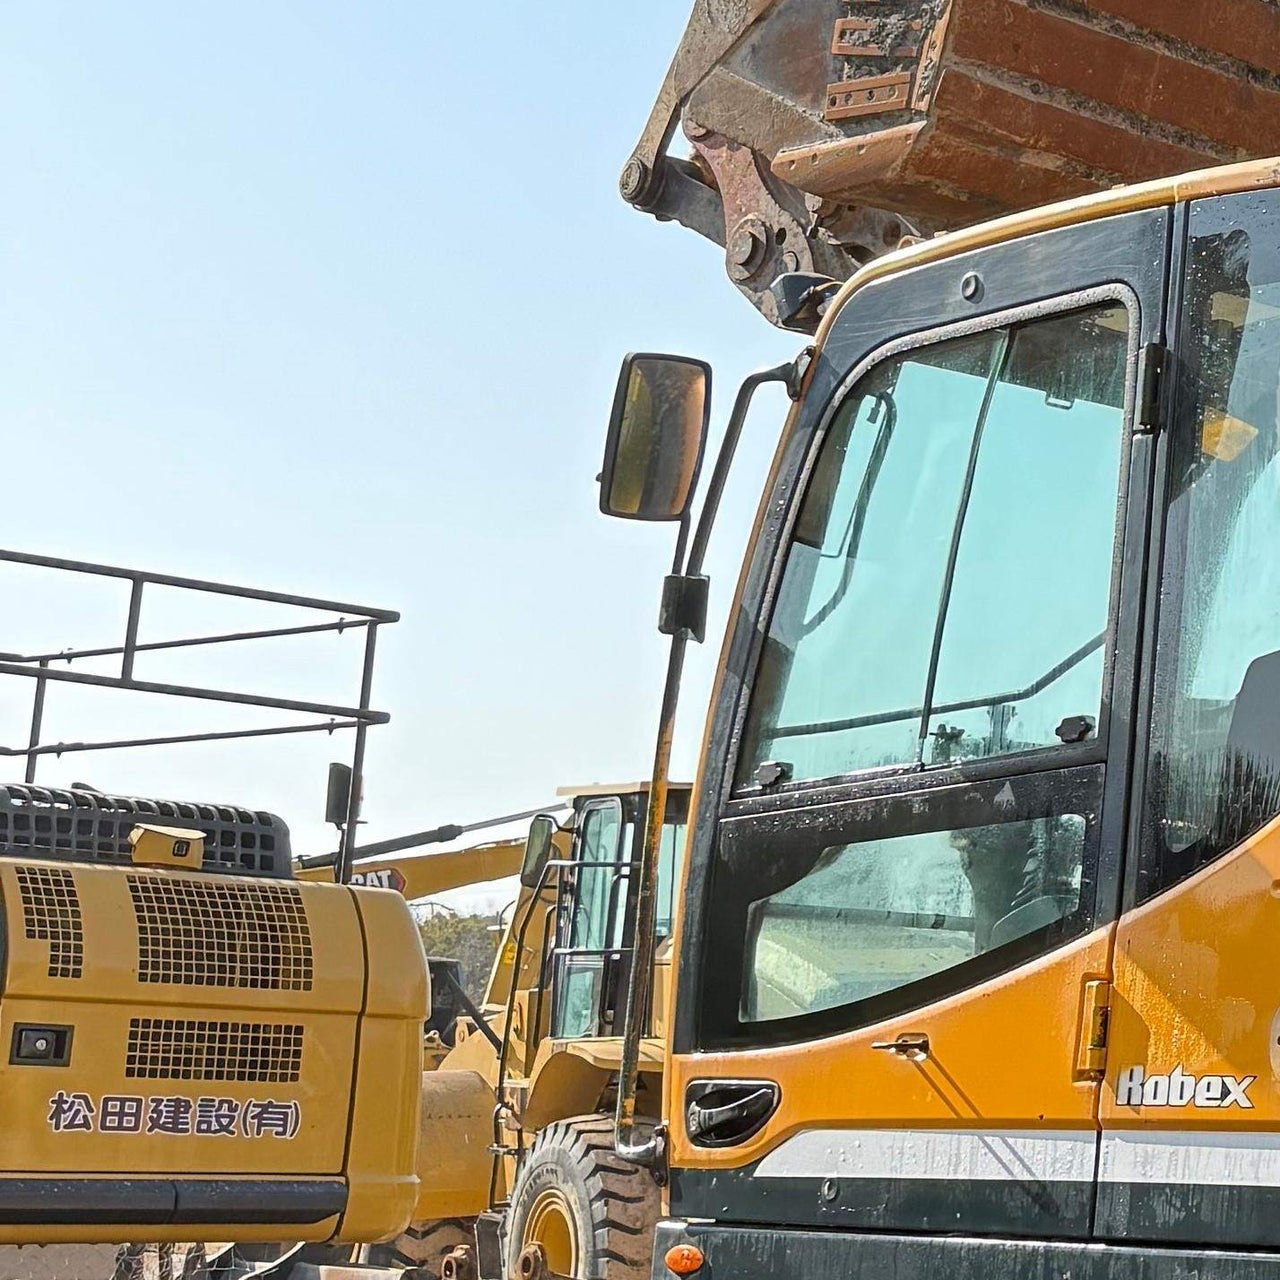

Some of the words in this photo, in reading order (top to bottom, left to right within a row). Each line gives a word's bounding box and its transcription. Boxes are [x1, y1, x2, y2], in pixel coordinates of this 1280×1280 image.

[47, 1090, 301, 1139] 松田建設(有)
